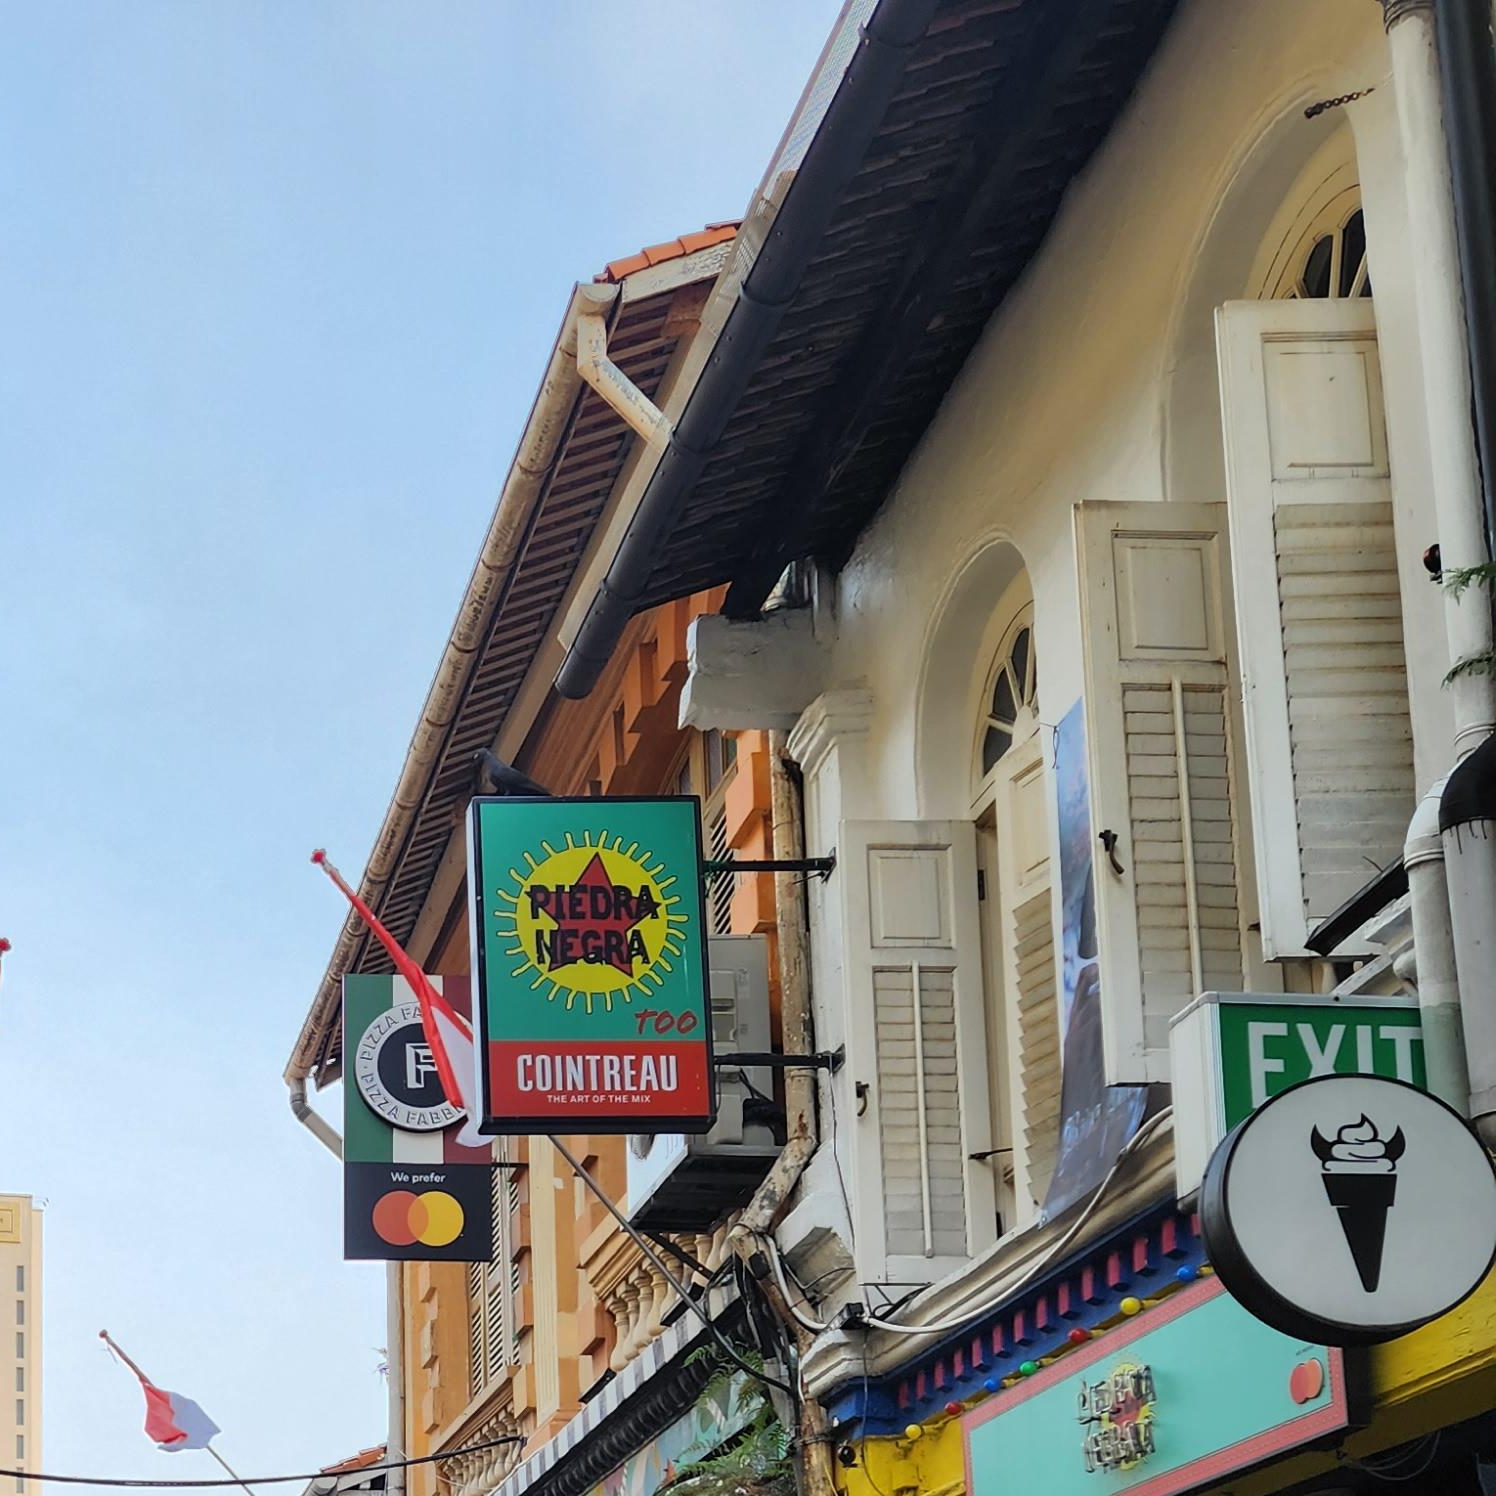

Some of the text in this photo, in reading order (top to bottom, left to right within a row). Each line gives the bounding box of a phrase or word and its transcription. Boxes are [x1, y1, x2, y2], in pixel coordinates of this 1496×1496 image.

[528, 884, 660, 920] PIEDRA
[535, 929, 650, 965] NEGRA
[359, 1014, 399, 1062] PIZZA
[516, 1054, 678, 1092] COINTREAU
[1247, 1021, 1424, 1109] EXIT
[361, 1072, 400, 1120] PIZZA
[547, 1094, 651, 1103] THE ART OF THE MIX
[390, 1172, 446, 1184] We prefer
